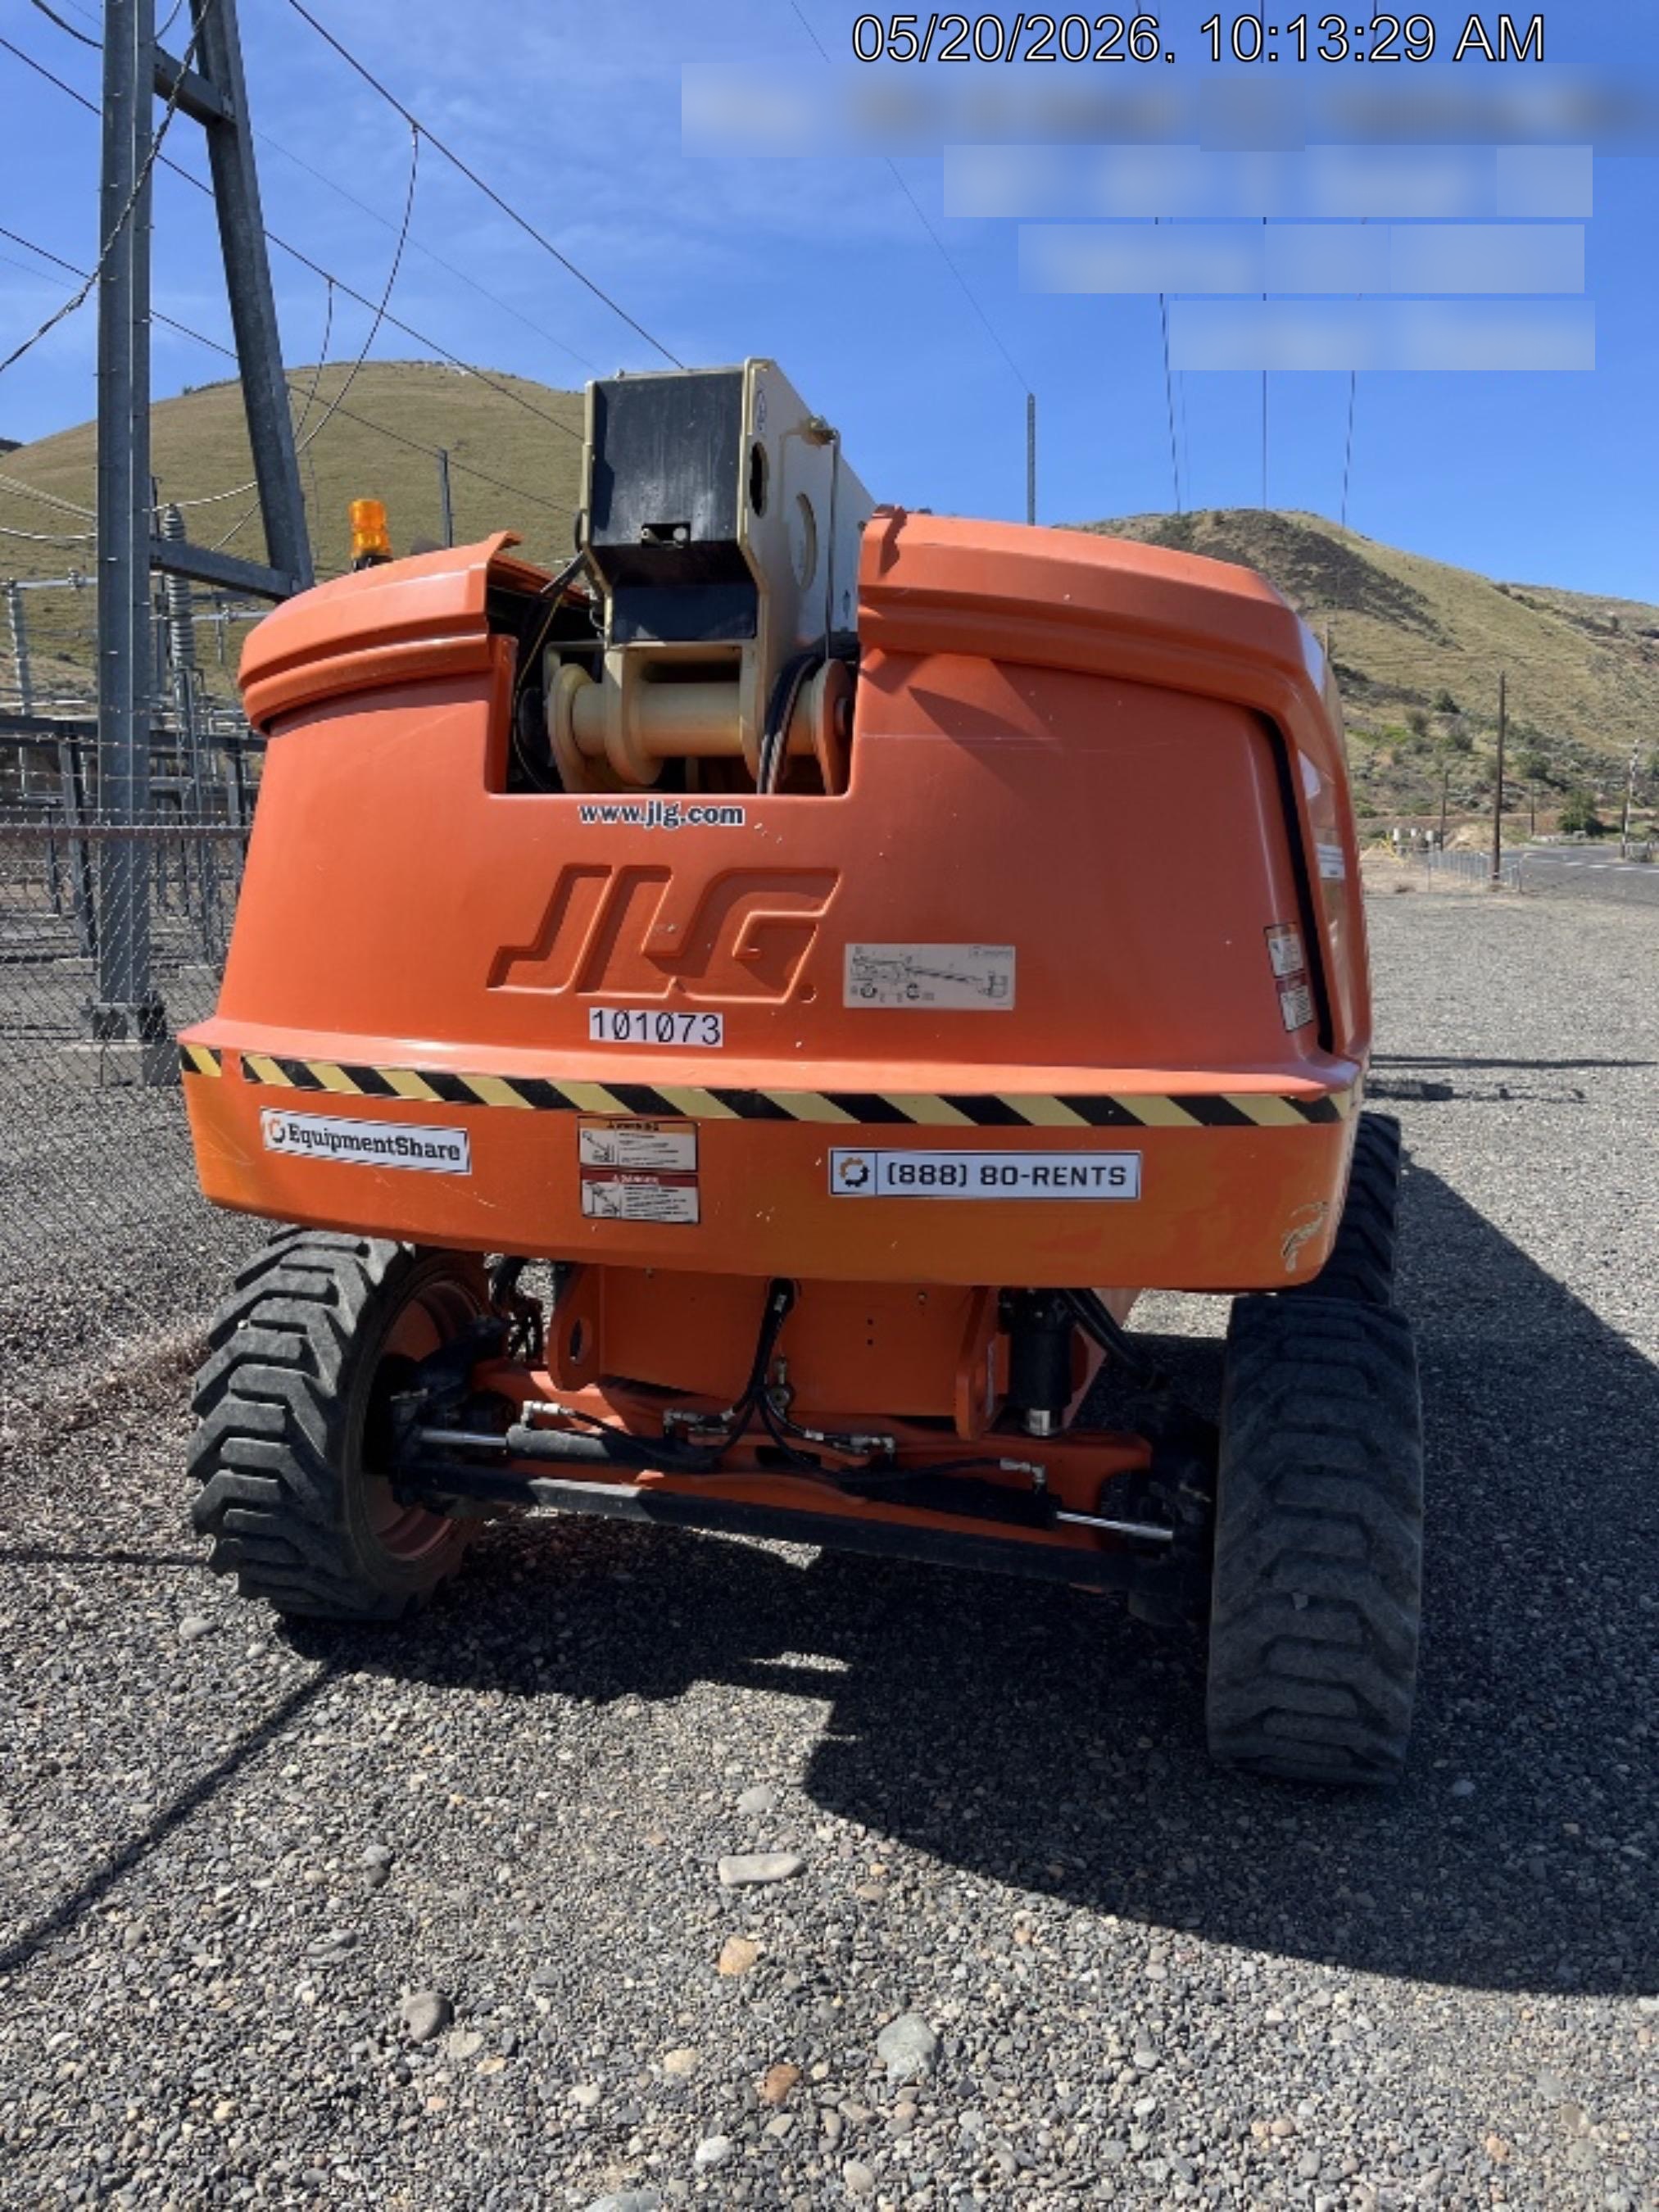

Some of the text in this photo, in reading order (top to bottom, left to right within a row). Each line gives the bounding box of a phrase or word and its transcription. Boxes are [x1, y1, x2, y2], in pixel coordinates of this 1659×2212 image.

[578, 800, 745, 829] www.jlg.com
[487, 864, 843, 1004] JLG
[591, 1009, 723, 1046] 101073
[288, 1122, 460, 1161] EquipmentShare
[887, 1162, 1126, 1188] (888) 80-RENTS
